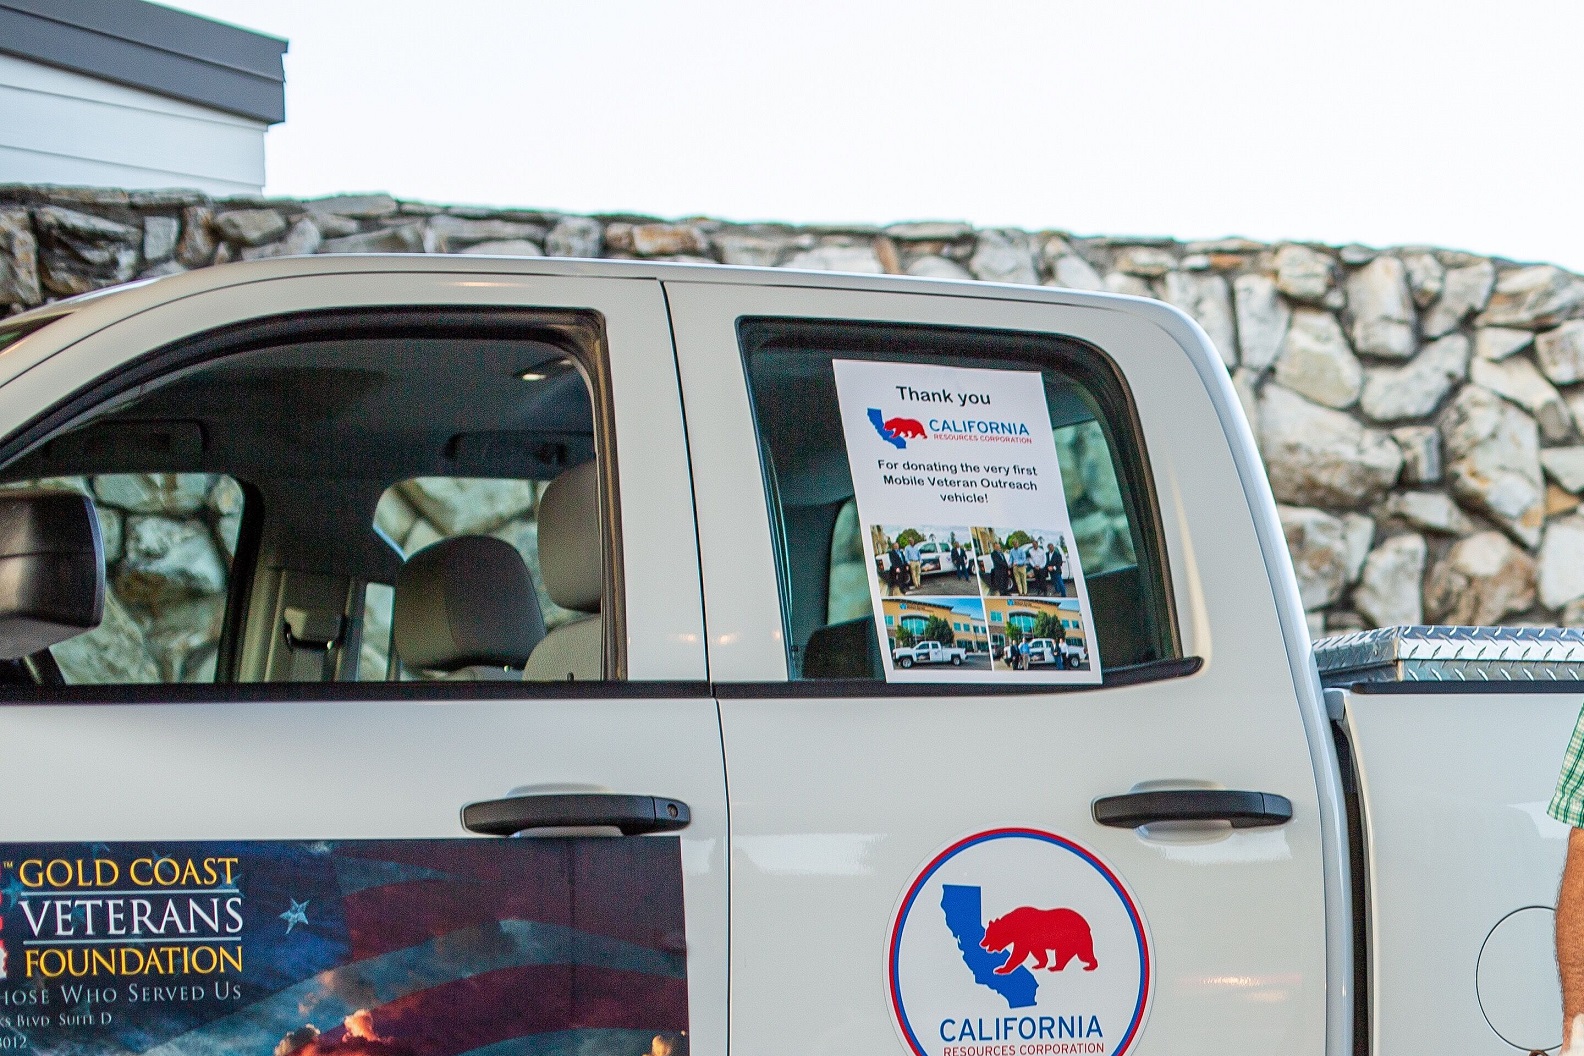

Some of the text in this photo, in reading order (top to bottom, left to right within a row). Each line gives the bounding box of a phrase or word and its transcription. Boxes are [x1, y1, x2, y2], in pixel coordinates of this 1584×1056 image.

[895, 385, 991, 407] Thank you
[929, 419, 1030, 436] CALIFORNIA
[933, 433, 1032, 444] RESOURCES CORPORATION
[877, 459, 1038, 477] For donating the very first
[883, 474, 1038, 491] Mobile Veteran Outreach
[940, 493, 989, 503] vehicle!
[19, 857, 239, 888] GOLD COAST
[18, 897, 244, 938] VETERANS
[25, 945, 243, 978] FOUNDATION
[101, 1011, 112, 1026] D
[939, 1015, 1104, 1042] CALIFORNIA
[0, 1034, 27, 1050] 012
[1019, 1042, 1105, 1056] CORPORATION
